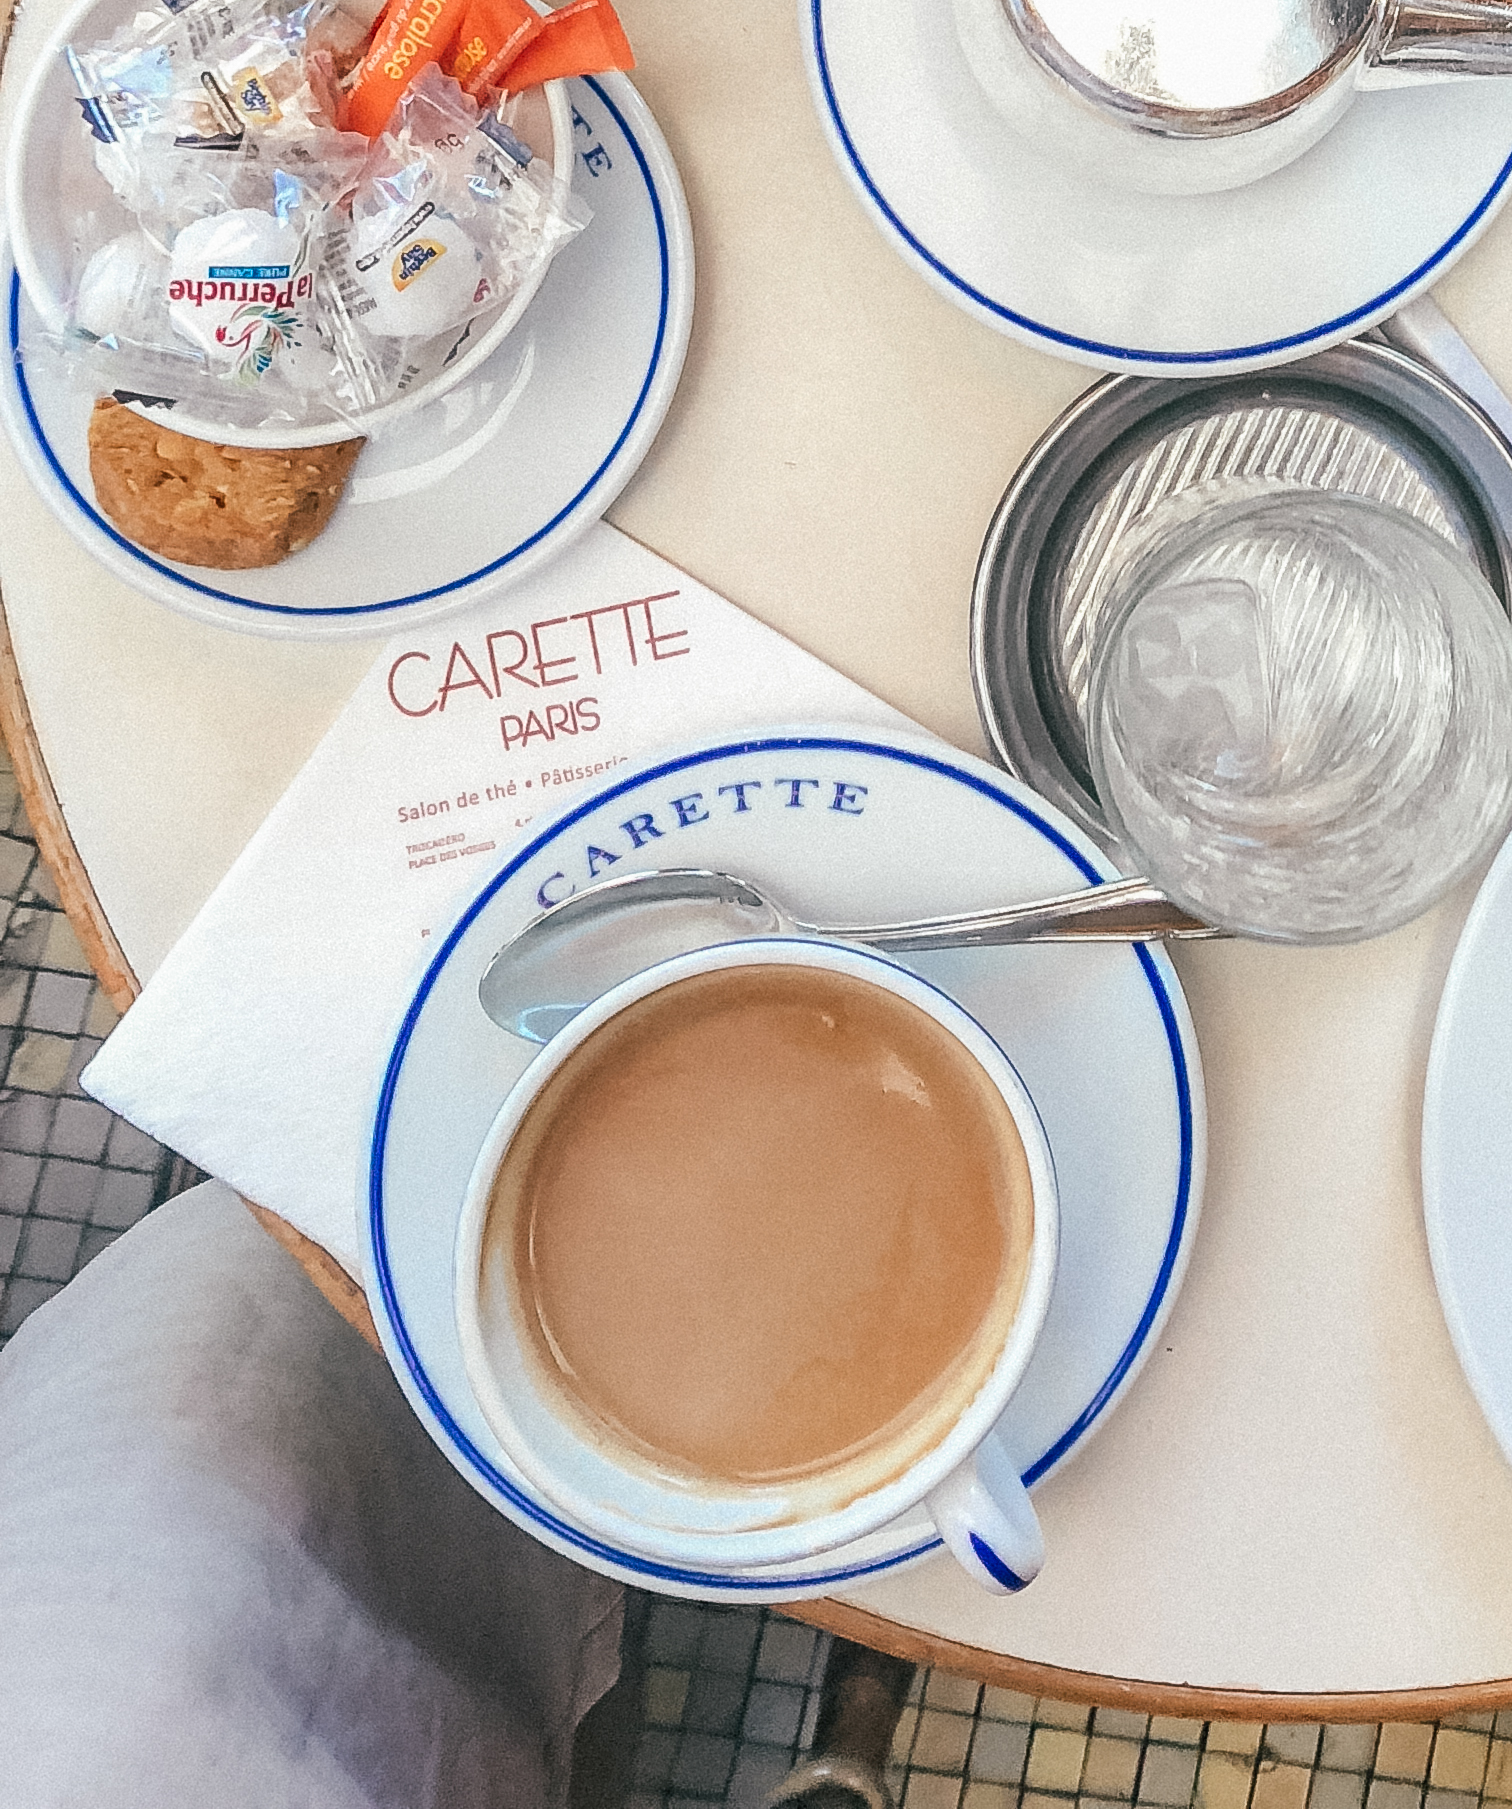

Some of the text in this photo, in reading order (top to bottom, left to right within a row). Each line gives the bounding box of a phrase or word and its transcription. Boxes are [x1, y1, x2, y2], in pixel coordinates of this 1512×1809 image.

[169, 272, 313, 309] la Perruche
[388, 589, 690, 718] CARETTE
[500, 696, 602, 751] PARIS
[397, 799, 450, 823] Salon
[456, 792, 480, 809] de
[485, 779, 517, 802] thé
[537, 778, 869, 910] CARETTE
